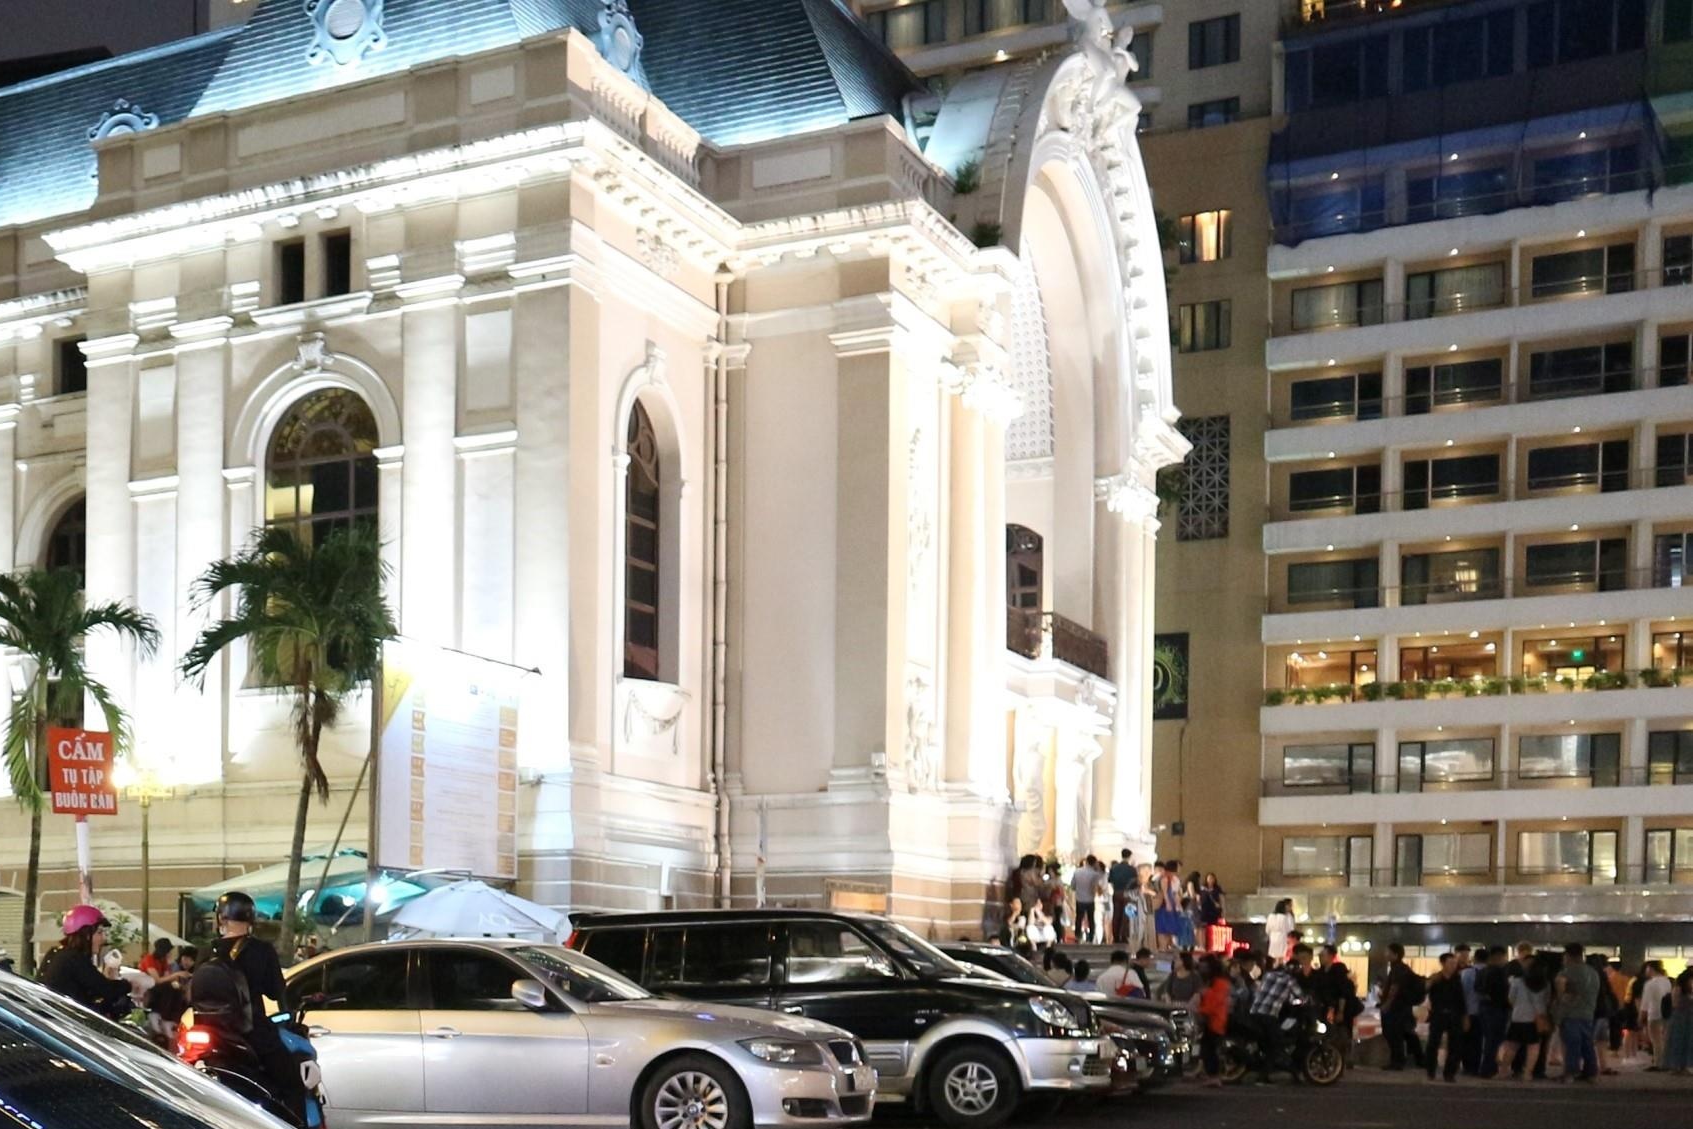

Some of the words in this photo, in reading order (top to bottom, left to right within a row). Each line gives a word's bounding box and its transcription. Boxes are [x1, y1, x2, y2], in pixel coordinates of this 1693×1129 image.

[57, 732, 105, 761] CẤM
[62, 767, 78, 789] TỤ
[81, 765, 104, 789] TẬP
[54, 789, 88, 809] BUÔN
[90, 791, 115, 810] BÁN
